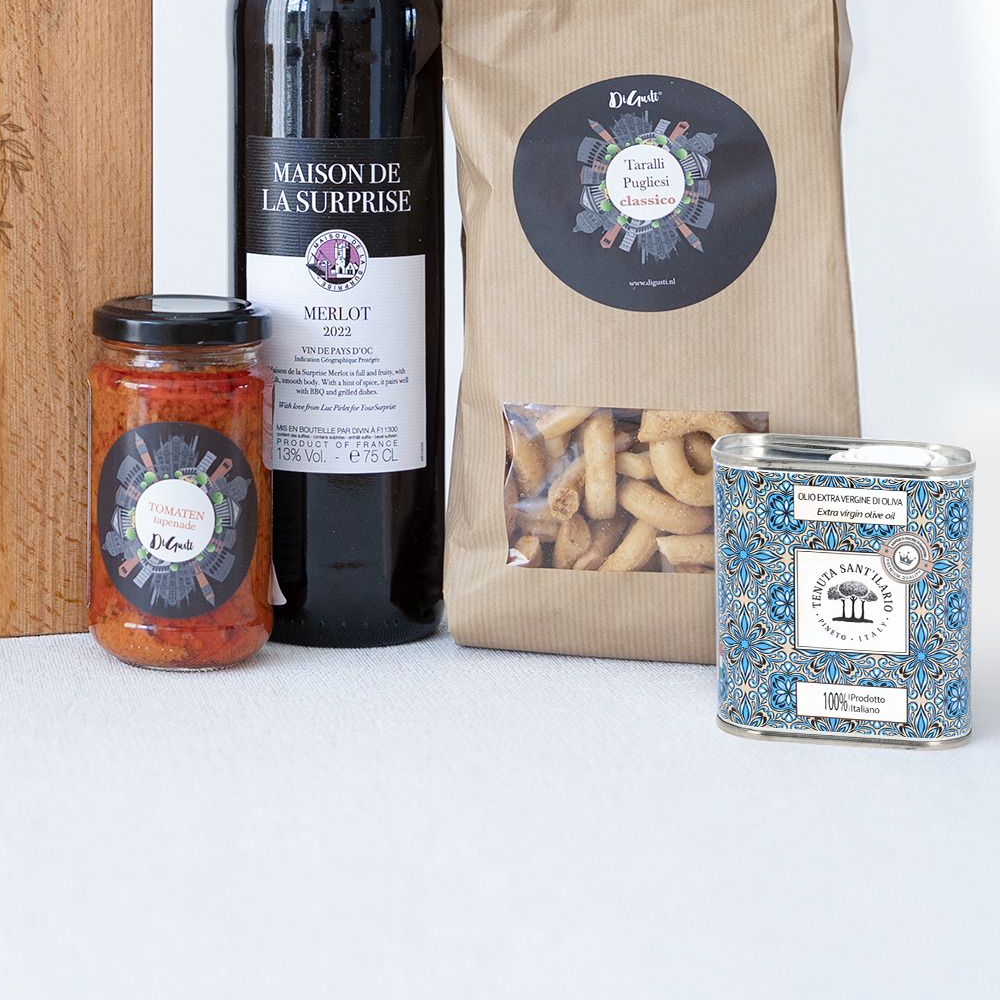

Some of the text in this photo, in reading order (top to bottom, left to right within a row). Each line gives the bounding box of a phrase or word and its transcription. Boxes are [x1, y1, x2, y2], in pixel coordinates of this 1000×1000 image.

[623, 158, 665, 171] Taralli
[273, 162, 401, 185] MAISON DE
[622, 175, 670, 192] Pugliesi
[262, 188, 412, 214] LA SURPRISE
[619, 194, 676, 207] classico
[628, 277, 676, 288] www.digusti.nl
[303, 305, 372, 321] MERLOT
[322, 325, 352, 337] 2022
[301, 346, 373, 355] VIN DE PAYS D'OC
[301, 368, 327, 378] Surprise
[309, 387, 325, 397] BBQ
[276, 424, 288, 432] MIS
[299, 425, 336, 434] BOUTEILLE
[276, 437, 398, 449] PRODUCT OF FRANCE
[276, 447, 302, 462] 13%
[304, 448, 326, 463] Vol.
[363, 449, 379, 463] 75
[381, 448, 399, 463] CL
[797, 492, 903, 506] OLIO EXTRA VERGINE DI OLIVA
[148, 501, 206, 521] TOMATEN
[816, 507, 896, 520] Extra virgin olive oil
[153, 515, 196, 531] tapenade
[811, 563, 894, 613] TENUTA SANT'ILARIO
[818, 617, 888, 642] PINETO ITALY
[823, 691, 886, 712] 100% Prodotto
[850, 704, 881, 714] Italiano
